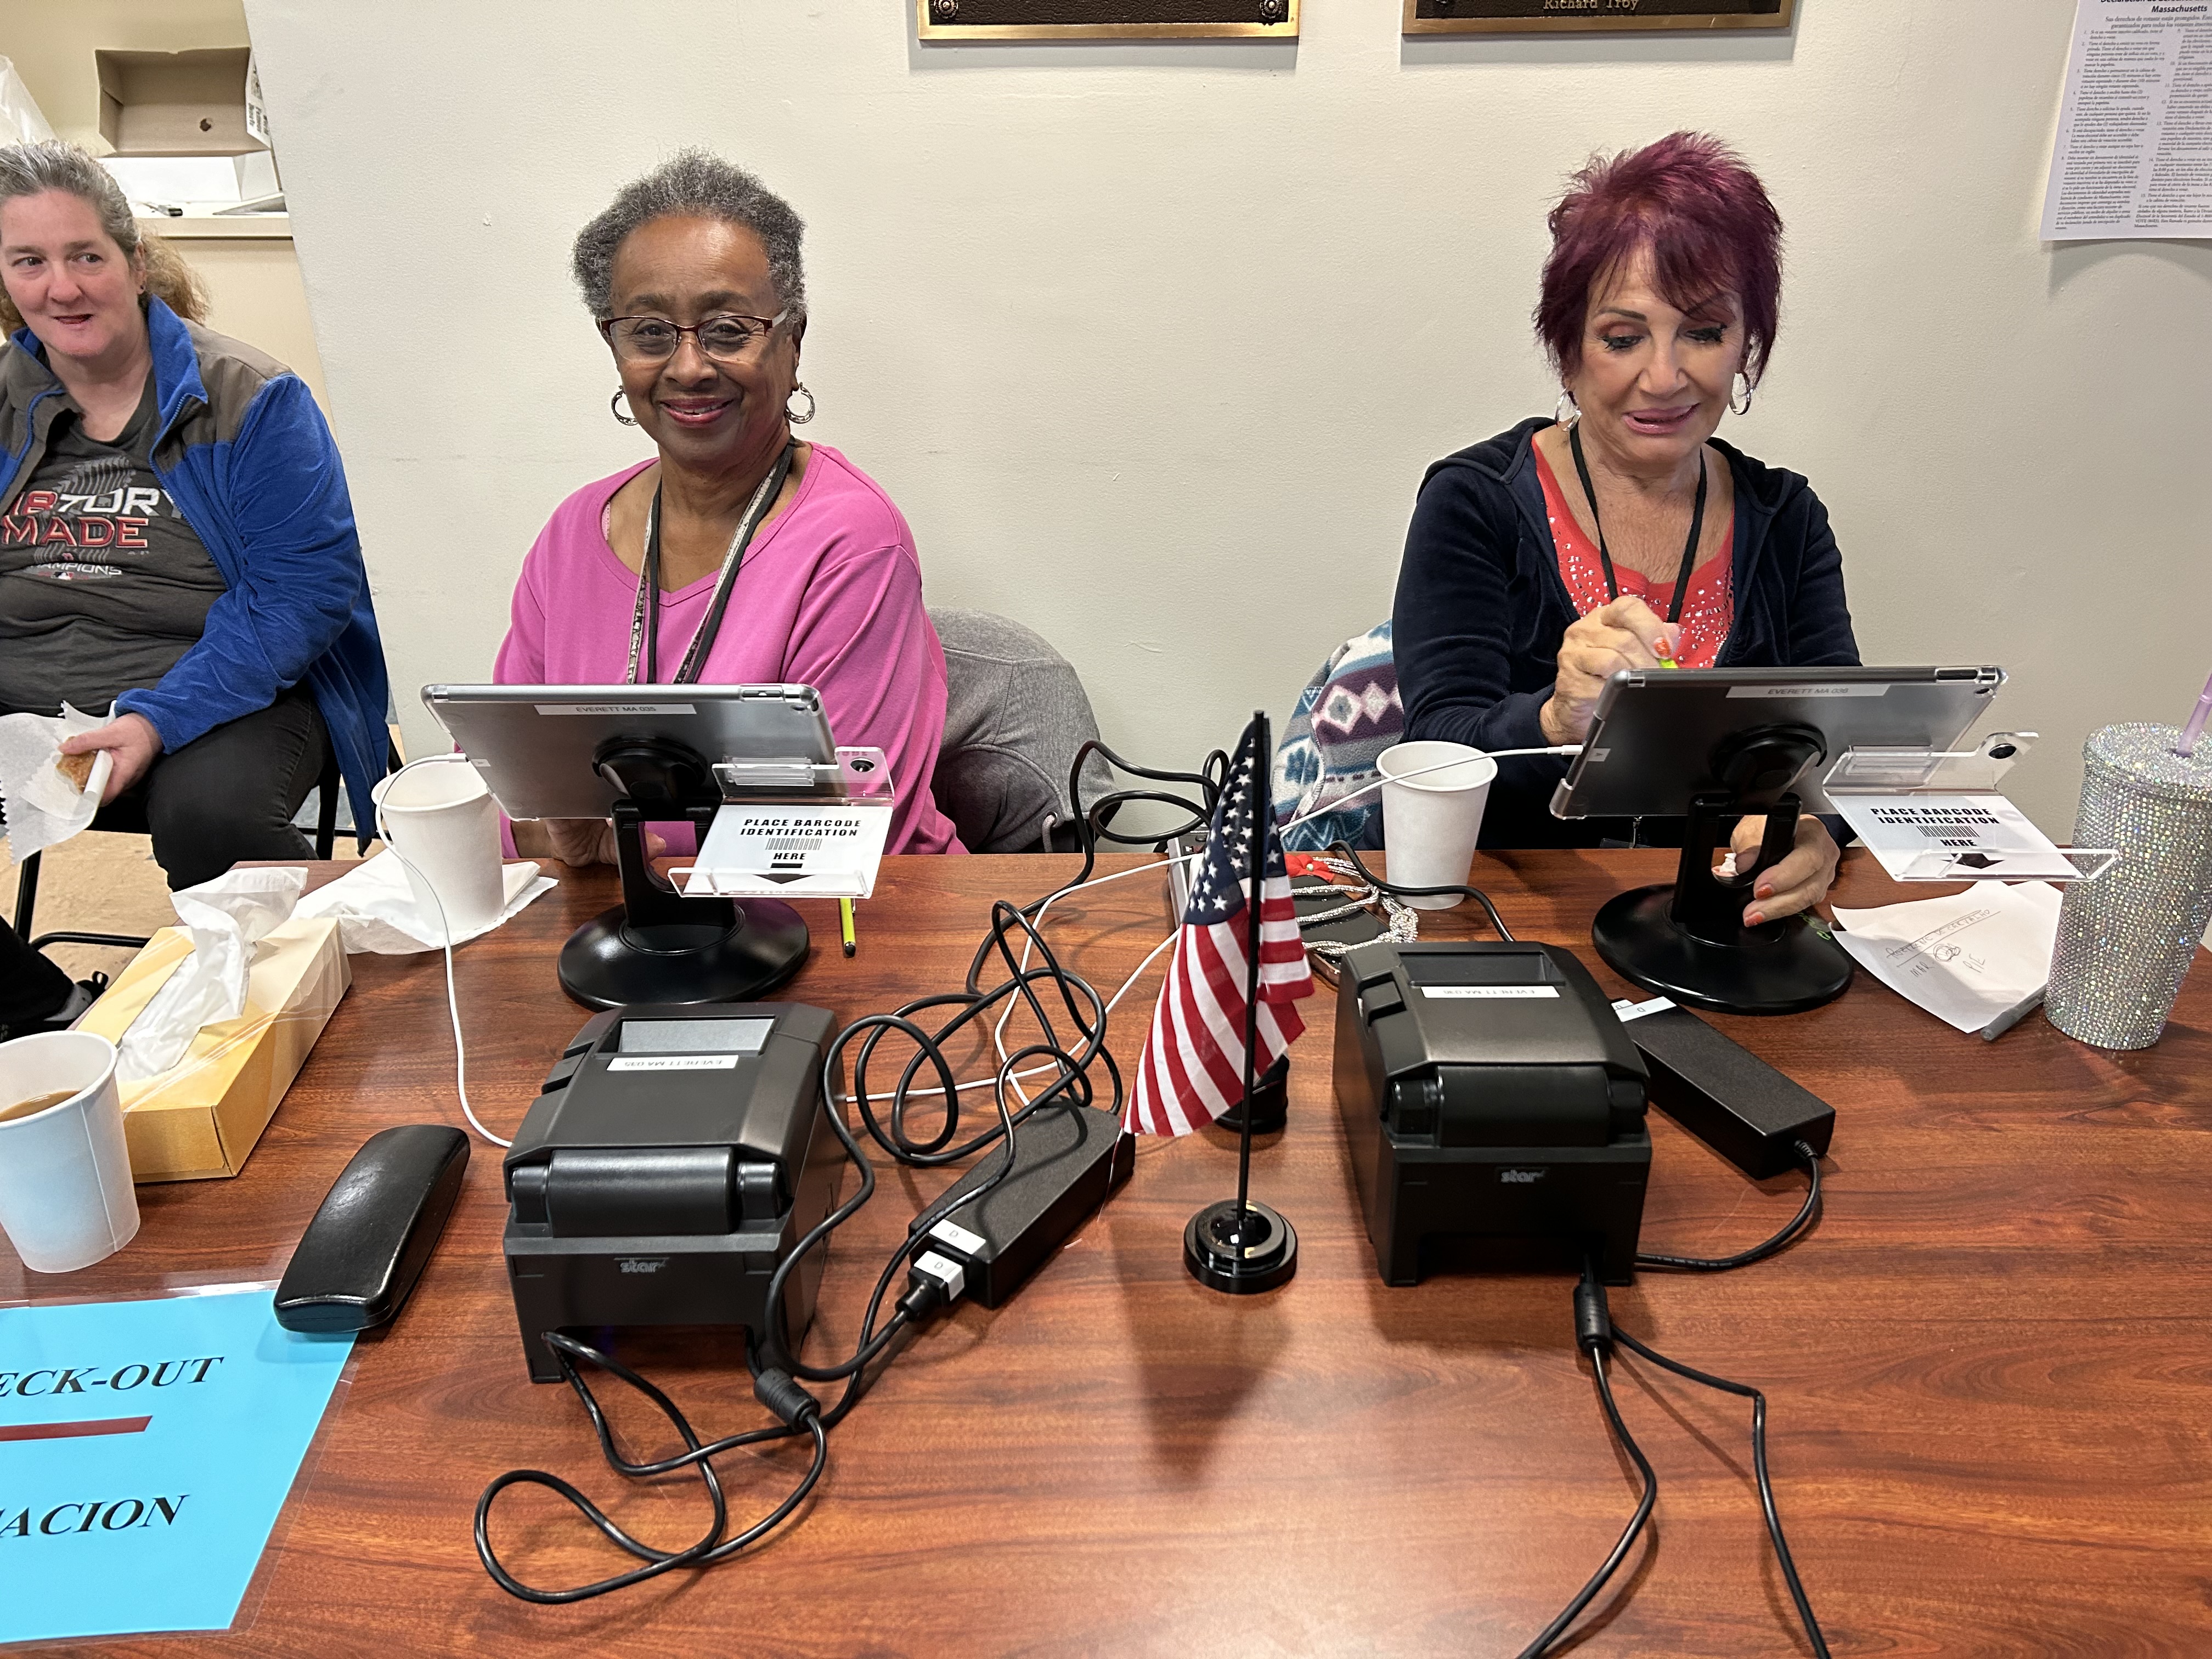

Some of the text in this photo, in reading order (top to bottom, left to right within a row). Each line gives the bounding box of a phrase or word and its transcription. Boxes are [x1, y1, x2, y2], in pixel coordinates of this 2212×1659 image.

[2151, 4, 2208, 13] Massachusetts
[2, 515, 149, 549] MADE
[743, 819, 789, 827] PLACE
[739, 828, 859, 837] IDENTIFICATION
[1940, 839, 1977, 847] HERE
[772, 852, 806, 860] HERE
[1500, 1169, 1545, 1183] star
[619, 1258, 667, 1273] star
[0, 1494, 190, 1538] ACION
